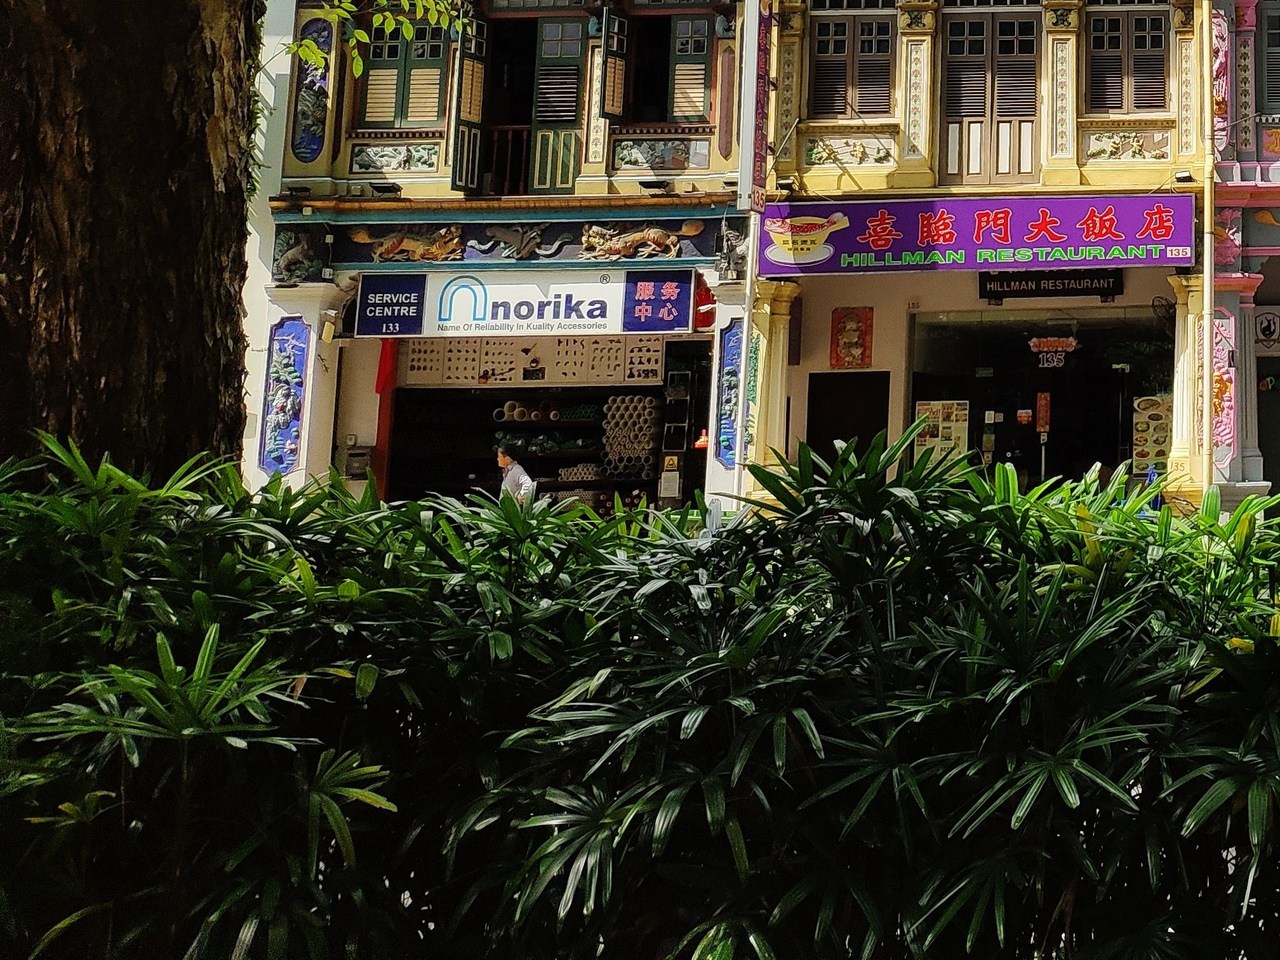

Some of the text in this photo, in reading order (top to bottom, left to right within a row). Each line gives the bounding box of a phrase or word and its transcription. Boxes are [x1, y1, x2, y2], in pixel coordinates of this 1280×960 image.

[752, 189, 765, 208] 135
[856, 203, 1175, 251] 喜臨門大飯店
[840, 244, 1165, 268] HILLMAN RESTAURANT
[1168, 247, 1189, 257] 135
[635, 281, 681, 300] 服务
[986, 278, 1115, 291] HILLMAN RESTAURANT
[367, 293, 418, 304] SERVICE
[366, 306, 418, 317] CENTRE
[490, 294, 608, 321] norika
[634, 302, 678, 322] 中心
[381, 323, 400, 333] 133
[437, 320, 608, 333] Name Of Reliability In Kuality Accessories
[1038, 352, 1066, 368] 135
[1170, 461, 1186, 473] 135
